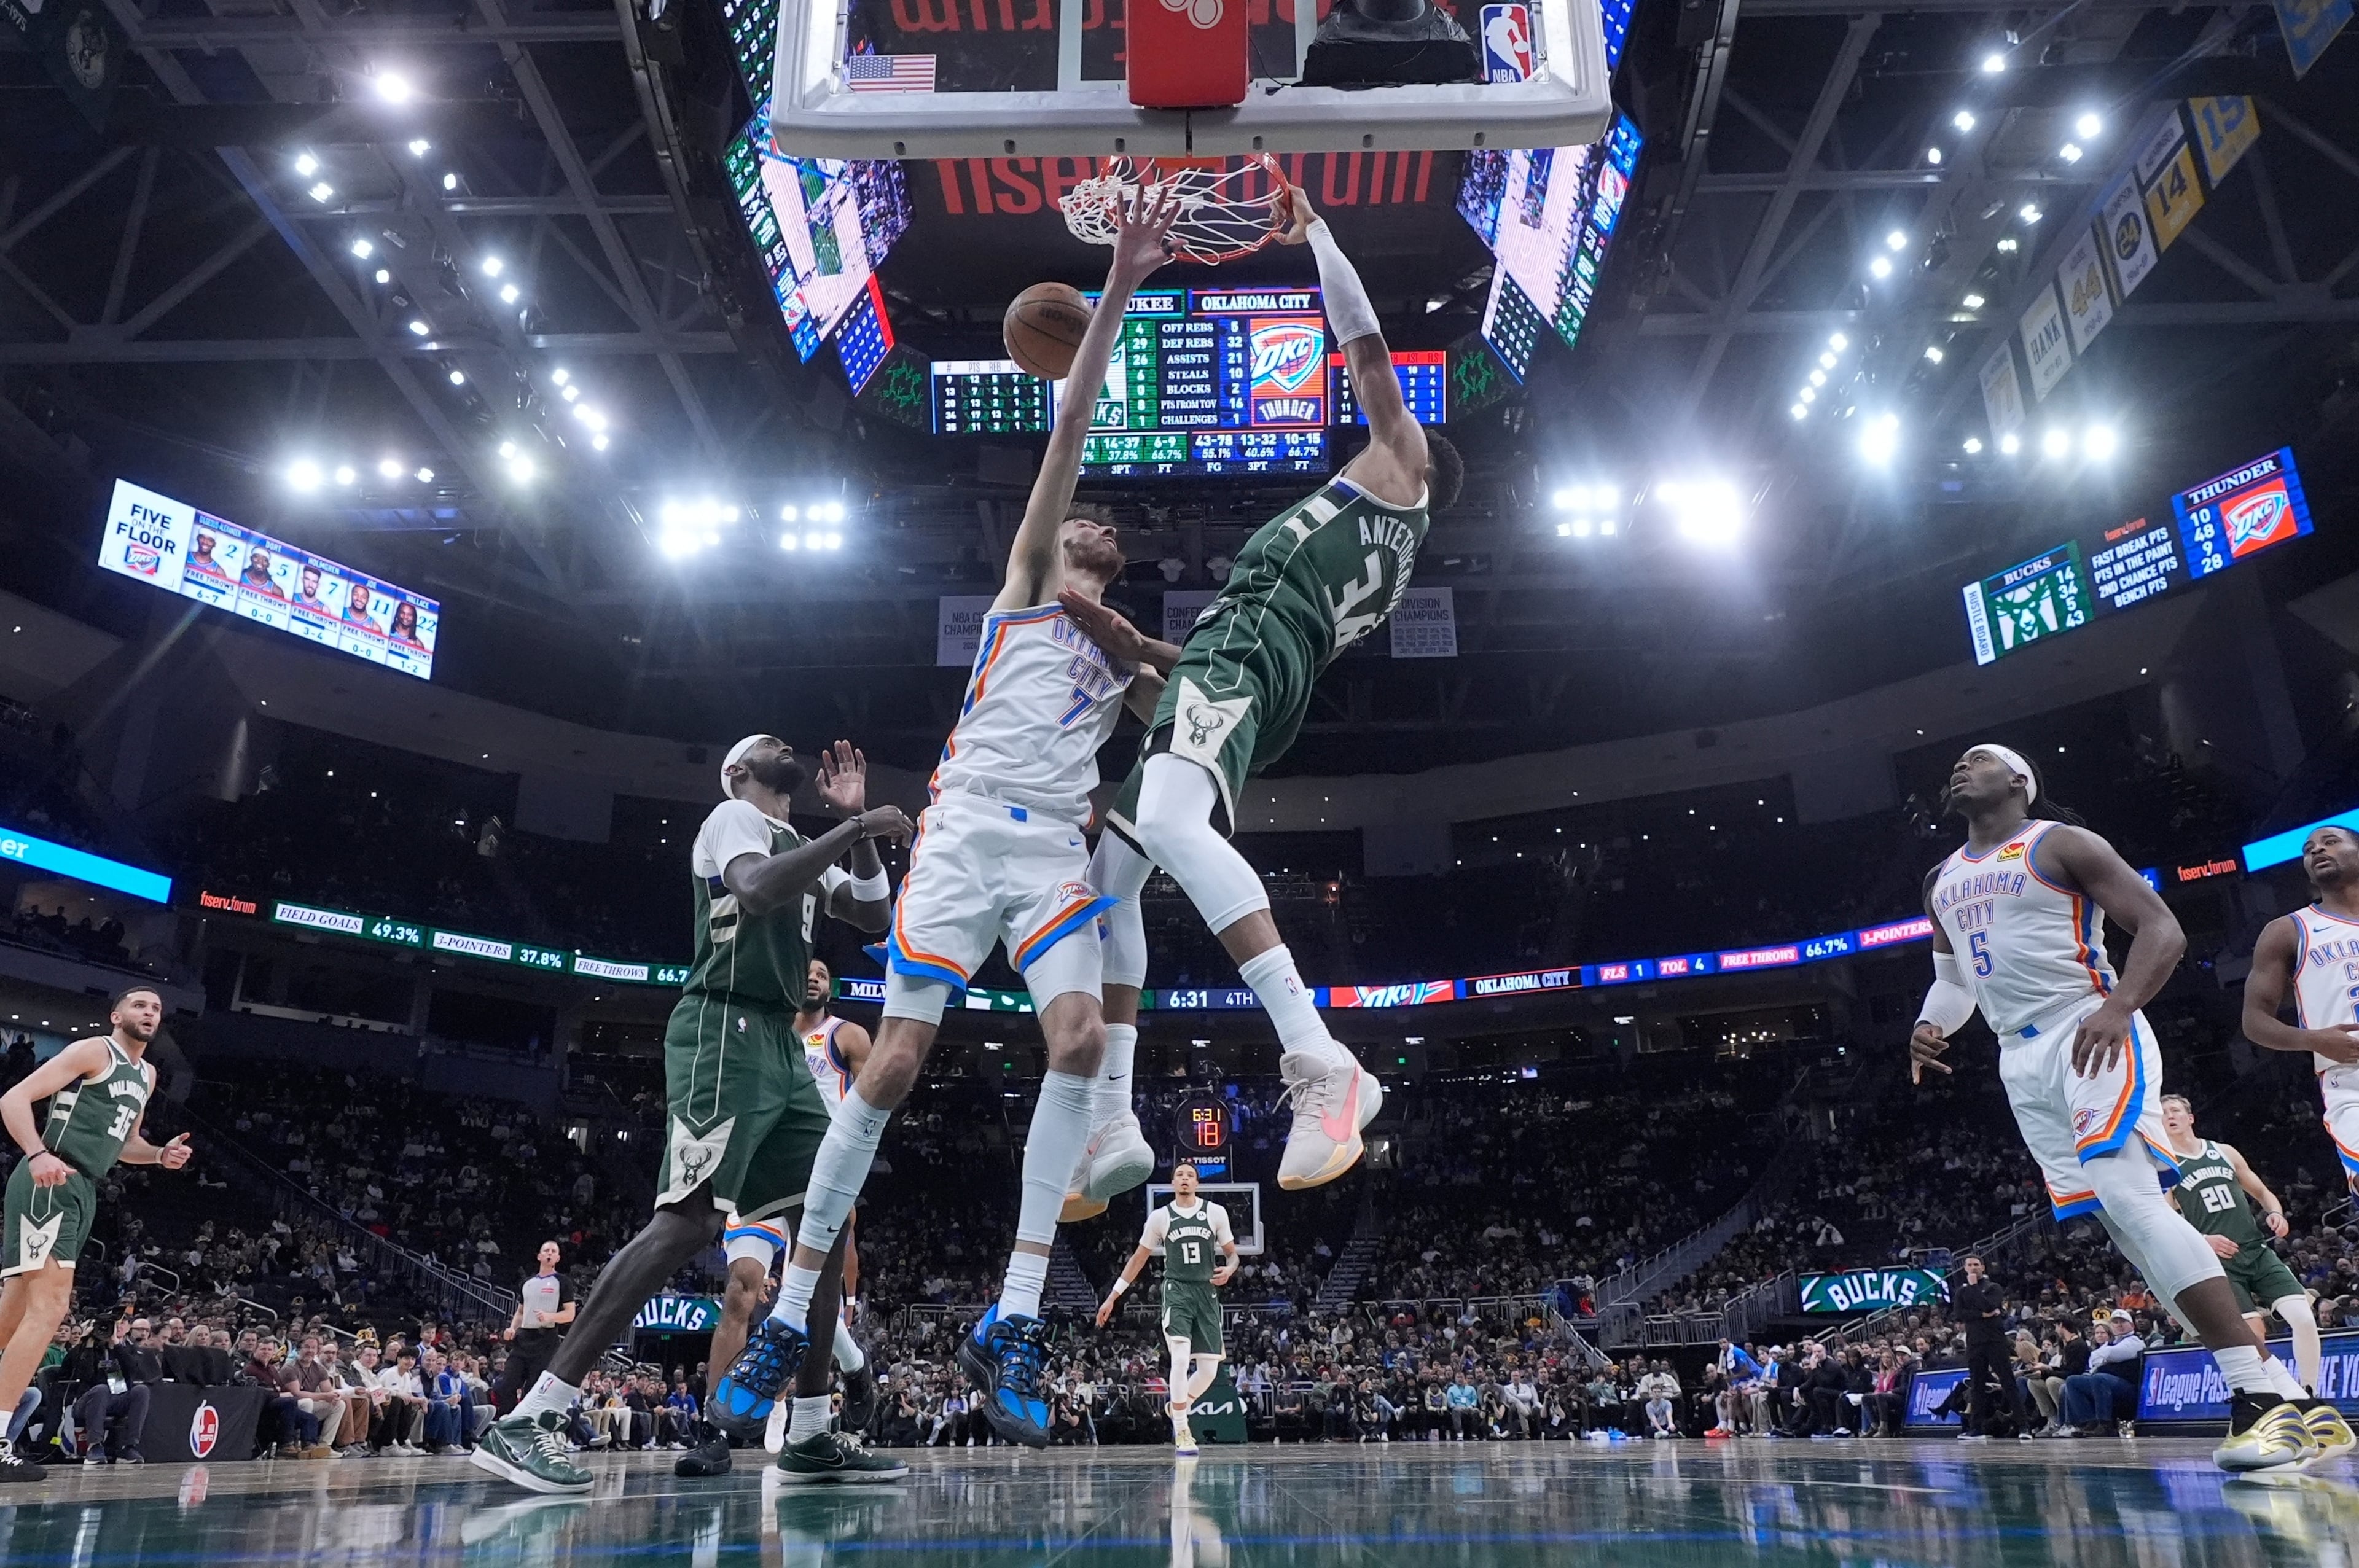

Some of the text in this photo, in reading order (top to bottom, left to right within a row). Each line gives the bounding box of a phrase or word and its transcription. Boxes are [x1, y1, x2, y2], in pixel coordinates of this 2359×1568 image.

[1492, 69, 1516, 82] NBA
[2156, 161, 2188, 217] 14
[1202, 294, 1311, 311] OKLAHOMA CITY
[1135, 322, 1214, 334] 4 OFF REBS
[1133, 337, 1242, 349] 29 DEF REBS 32
[2030, 313, 2061, 364] HANK
[969, 362, 980, 372] PTS
[1133, 353, 1242, 365] 26 ASSISTS 21
[1251, 337, 1311, 379] OKC
[1407, 353, 1439, 363] AST FLS
[1137, 368, 1243, 381] 6 STEALS 10
[1407, 365, 1418, 375] 10
[1167, 383, 1240, 394] BLOCKS 2
[1161, 397, 1243, 410] PTS FROM TOV 16
[1259, 399, 1316, 421] THUNDER
[971, 410, 981, 419] 17
[1161, 415, 1218, 425] CHALLENGES
[1340, 415, 1352, 423] 22
[971, 423, 981, 431] 11
[1104, 432, 1321, 448] 14-37 6-9 43-78 13-32 10-15
[1108, 446, 1320, 461] 37.8% 66.7% 55.1% 40.6% 66.7%
[1111, 460, 1309, 475] 3PT FT FG 3PT FT
[2188, 459, 2277, 505] THUNDER
[131, 504, 171, 529] FIVE
[2189, 508, 2211, 527] 10
[132, 519, 165, 536] ON THE
[2194, 523, 2215, 542] 48
[116, 522, 176, 555] FLOOR
[265, 540, 282, 552] DORT
[2091, 526, 2169, 569] FAST BREAK PTS
[225, 545, 237, 558] 2
[2202, 541, 2213, 556] 9
[276, 564, 289, 577] 5
[308, 557, 340, 575] HOLMGREN
[2003, 556, 2052, 585] BUCKS
[2094, 540, 2173, 584] PTS IN THE PAINT
[2201, 553, 2223, 574] 28
[186, 569, 234, 591] FREE THROWS
[2056, 566, 2075, 584] 14
[2098, 556, 2178, 599] 2ND CHANCE PTS
[328, 582, 338, 595] 7
[366, 579, 377, 590] JOE
[2058, 580, 2079, 599] 34
[2114, 576, 2168, 608] BENCH PTS
[241, 589, 287, 609] FREE THROWS
[372, 599, 391, 615] 11
[406, 594, 429, 610] WALLACE
[1401, 598, 1440, 609] DIVISION
[2065, 596, 2077, 611] 5
[294, 608, 337, 628] FREE THROWS
[417, 616, 437, 633] 22
[953, 612, 970, 623] NBA
[1395, 610, 1449, 622] CHAMPIONS
[1968, 590, 1990, 657] HUSTLE BOARD
[2065, 610, 2085, 627] 43
[343, 626, 385, 644] FREE THROWS
[944, 625, 982, 635] CHAMPI
[390, 643, 430, 660] FREE THROWS
[1067, 654, 1114, 701] CITY
[1055, 684, 1096, 730] 7
[2178, 859, 2237, 881] fiserv.forum
[200, 891, 256, 914] fiserv.forum
[1934, 870, 2027, 919] OKLAHOMA
[801, 892, 817, 944] 9
[1955, 899, 1993, 932] CITY
[278, 907, 689, 983] FIELD GOALS 49.3% 3-POINTERS 37.8% FREE THROWS 66.7
[1968, 929, 1995, 978] 5
[2307, 937, 2359, 968] OKLA
[1476, 920, 1933, 994] OKLAHOMA CITY FLS 1 TOL 4 FREE THROWS 66.7% 3-POINTERS
[1170, 991, 1253, 1008] 6:31 4TH
[108, 1104, 138, 1142] 35
[1193, 1108, 1221, 1121] 6:31
[1198, 1122, 1218, 1146] 18
[2180, 1166, 2234, 1192] MILWAUKEE
[2199, 1184, 2236, 1213] 20
[1167, 1226, 1212, 1243] MILWAUKEE
[1181, 1242, 1200, 1264] 13
[1827, 1273, 1917, 1311] BUCKS
[2157, 1368, 2202, 1411] League
